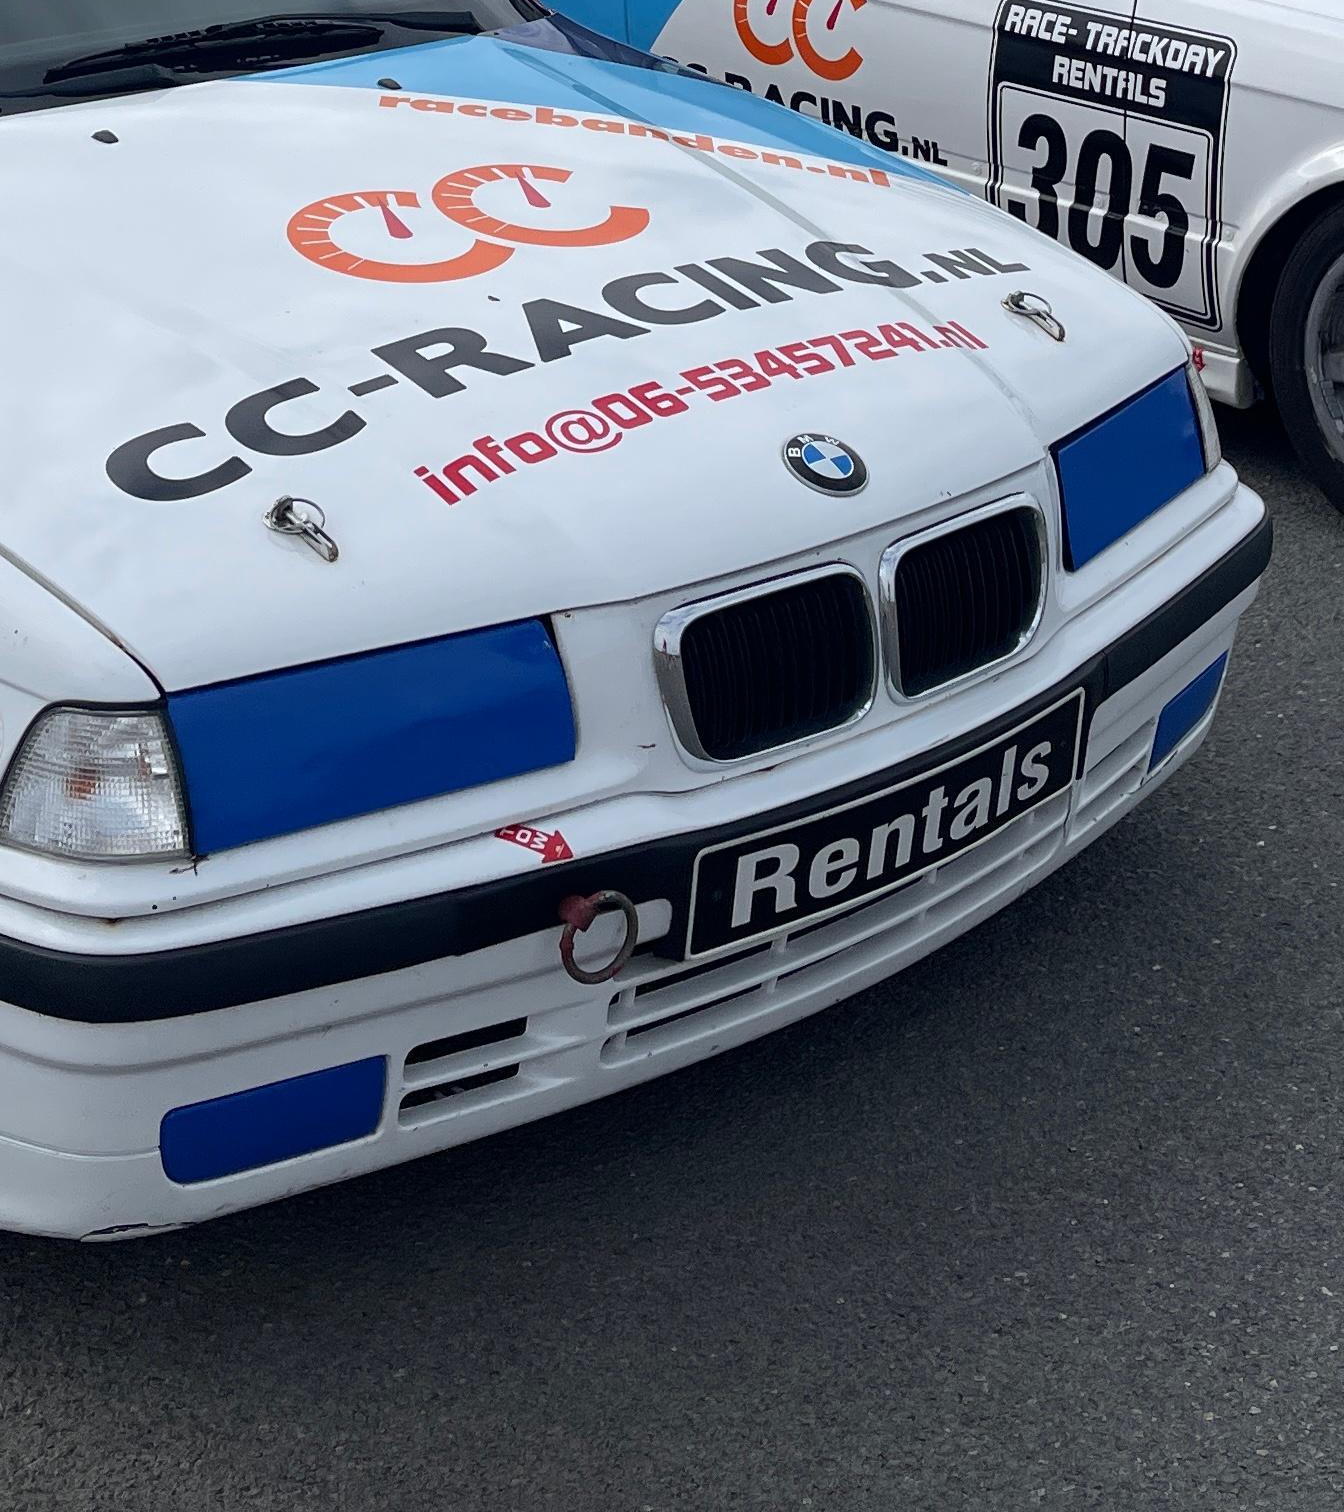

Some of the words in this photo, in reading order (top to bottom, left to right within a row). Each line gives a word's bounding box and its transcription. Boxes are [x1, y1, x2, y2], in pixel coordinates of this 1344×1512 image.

[1004, 4, 1079, 44] RACE-
[1086, 21, 1225, 78] TRACKDAY
[1052, 55, 1167, 108] RENTALS
[378, 93, 892, 188] racebanden.nl
[662, 56, 949, 167] ACING.NL
[286, 163, 651, 284] CC
[1007, 113, 1196, 289] 305
[105, 239, 1030, 502] CC-RACING.NL
[413, 319, 991, 506] info@06-53457241.nl
[787, 434, 840, 458] BMW
[730, 740, 1052, 929] Rentals
